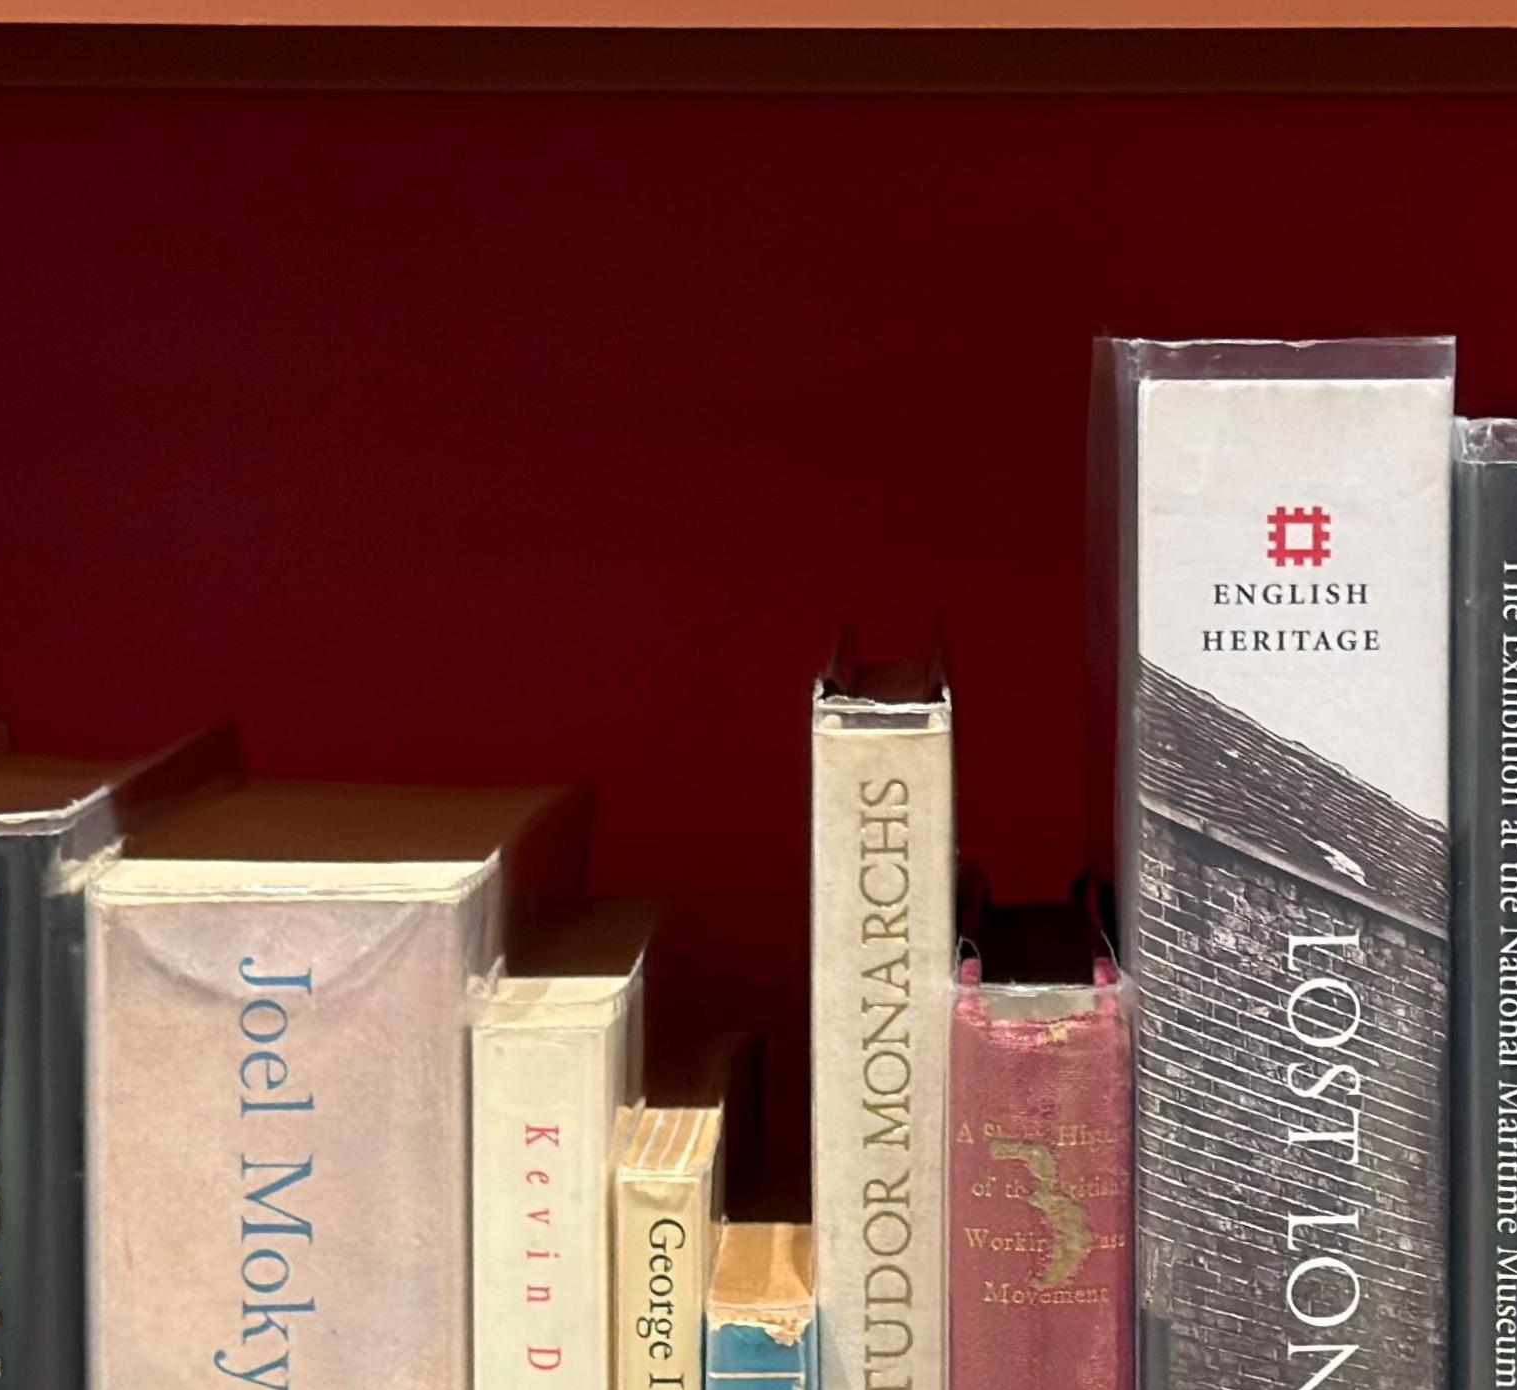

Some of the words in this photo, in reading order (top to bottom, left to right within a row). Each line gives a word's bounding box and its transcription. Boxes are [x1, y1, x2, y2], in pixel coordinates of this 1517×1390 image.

[1213, 583, 1369, 605] ENGLISH
[1202, 630, 1380, 652] HERITAGE
[859, 777, 912, 1152] MONARCHS
[238, 958, 313, 1120] Joel
[1286, 933, 1360, 1165] LOST
[956, 1123, 974, 1143] A
[525, 1123, 560, 1305] Kevin
[971, 1177, 996, 1197] of
[1006, 1179, 1029, 1198] th
[636, 1217, 683, 1361] George
[984, 1281, 1109, 1304] Movement
